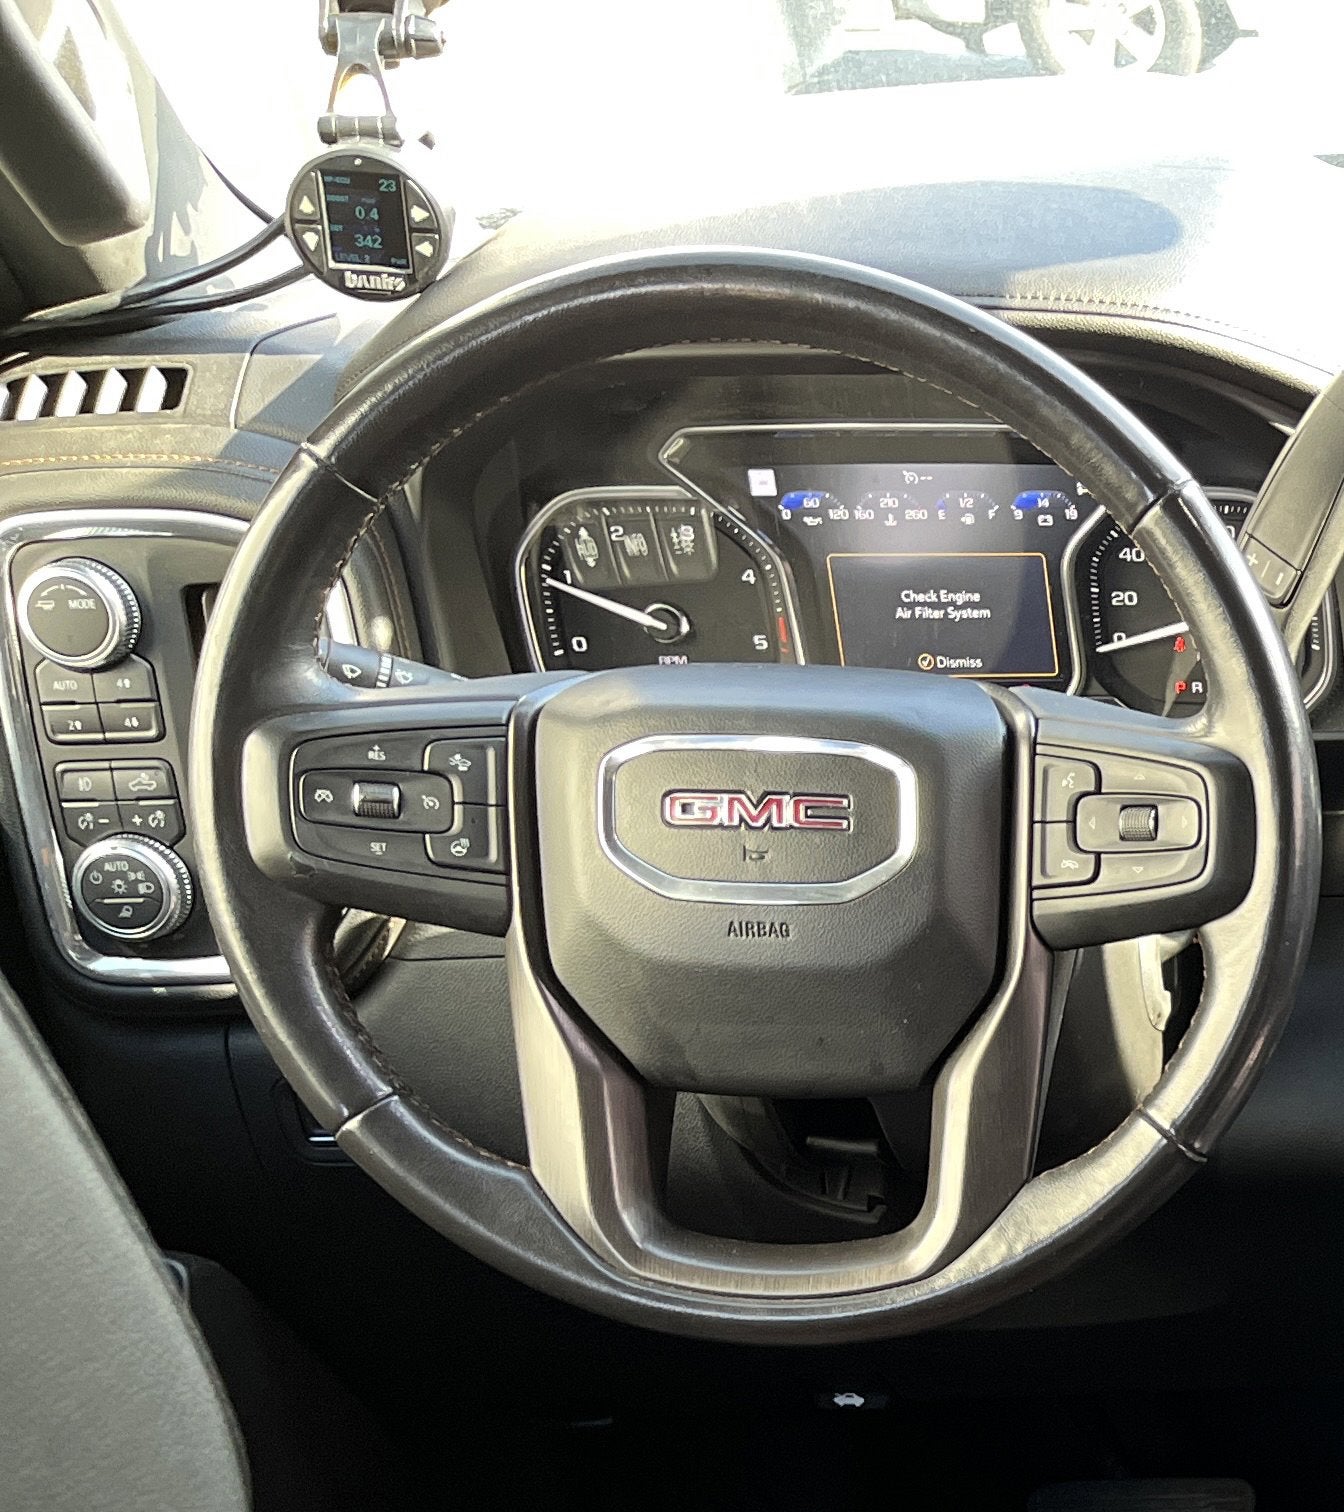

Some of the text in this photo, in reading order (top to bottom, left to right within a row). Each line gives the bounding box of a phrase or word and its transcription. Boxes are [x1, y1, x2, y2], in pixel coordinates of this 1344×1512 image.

[379, 179, 397, 192] 23
[354, 233, 383, 249] 342
[879, 498, 899, 508] 210
[1036, 498, 1050, 508] 14
[781, 509, 792, 520] 0
[828, 508, 849, 520] 120
[854, 509, 875, 520] 160
[904, 509, 929, 520] 260
[1013, 510, 1023, 520] 9
[1064, 508, 1078, 520] 19
[609, 525, 624, 542] 2
[1118, 547, 1145, 562] 40
[562, 569, 572, 584] 1
[741, 568, 757, 585] 4
[900, 589, 981, 606] Check Engine
[1110, 591, 1138, 606] 20
[68, 599, 97, 610] MODE
[895, 607, 991, 622] Air Filter System
[570, 636, 588, 653] 0
[751, 634, 769, 651] 5
[936, 656, 983, 668] Dismiss
[52, 680, 78, 691] AUTO
[1174, 680, 1187, 694] P
[1191, 681, 1203, 694] R
[367, 751, 386, 761] RES
[663, 791, 852, 830] GMC
[370, 842, 387, 853] SET
[104, 860, 129, 872] AUTO
[727, 920, 791, 940] AIRBAG
